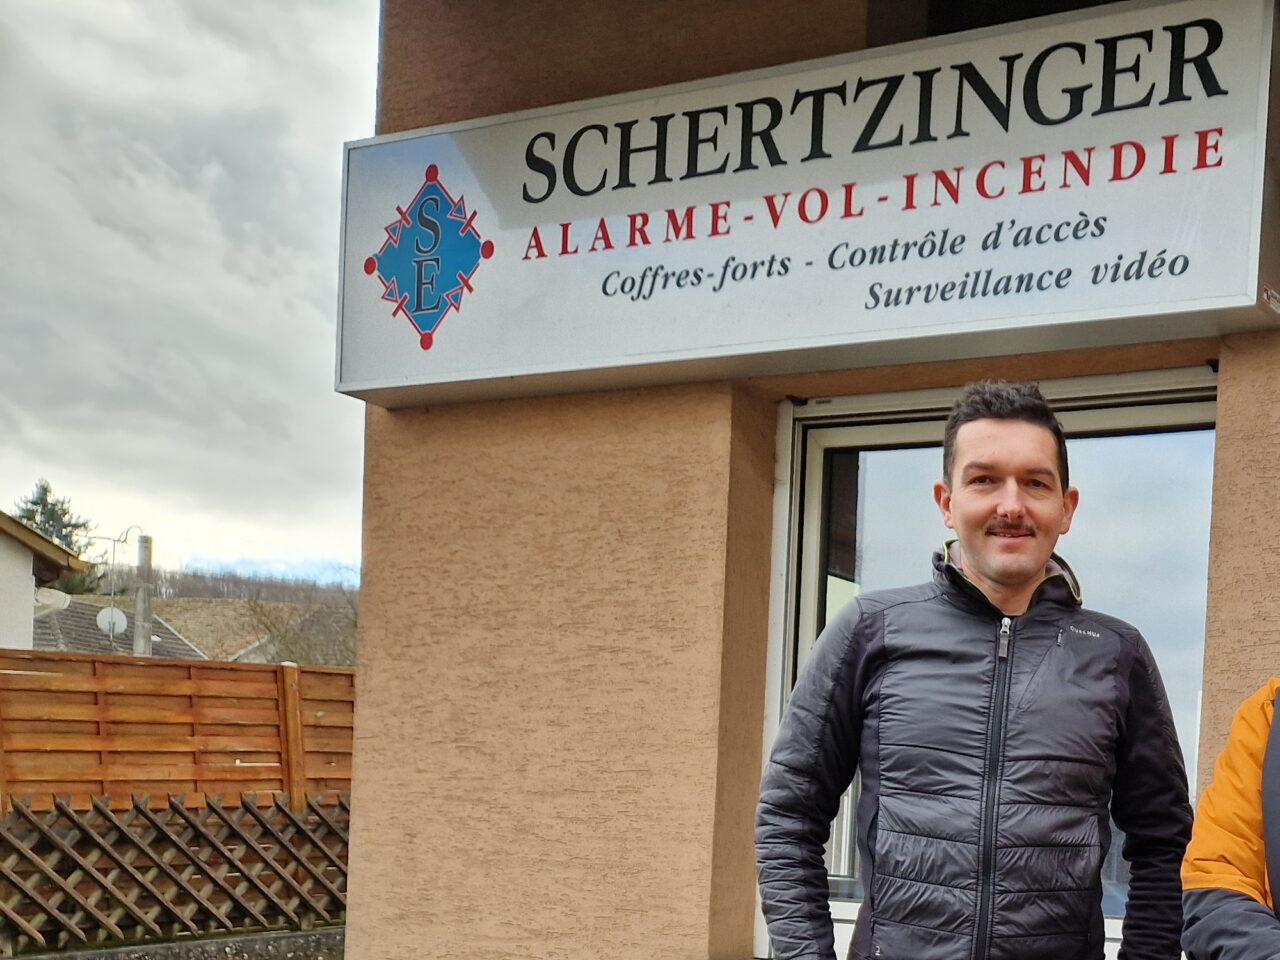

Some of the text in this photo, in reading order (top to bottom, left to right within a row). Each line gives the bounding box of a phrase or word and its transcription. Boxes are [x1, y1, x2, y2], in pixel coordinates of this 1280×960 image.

[522, 18, 1229, 204] SCHERTZINGER
[601, 253, 790, 301] Coffres-forts
[828, 228, 966, 270] Contrôle
[981, 211, 1108, 251] d'accès
[864, 249, 1190, 310] Surveillance vidéo
